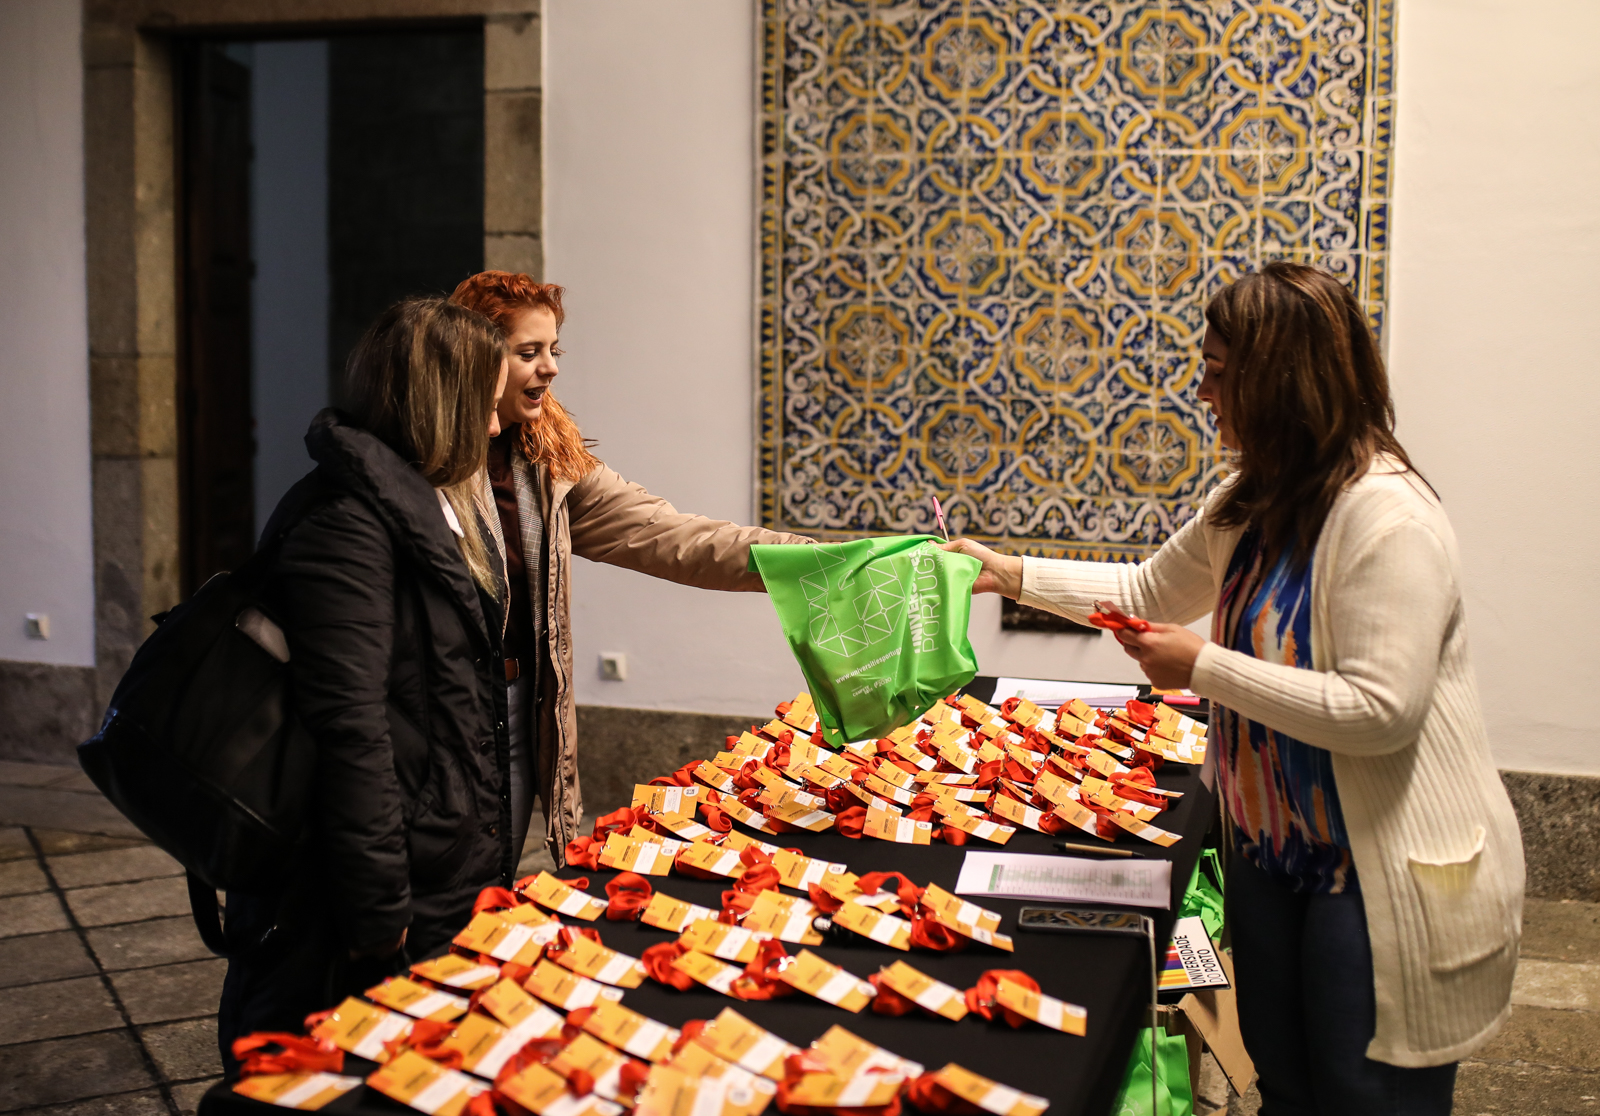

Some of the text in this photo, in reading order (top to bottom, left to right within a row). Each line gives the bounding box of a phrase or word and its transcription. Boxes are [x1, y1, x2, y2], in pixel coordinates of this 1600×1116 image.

[1174, 934, 1206, 985] UNIVERSIDADE
[1197, 949, 1224, 983] DO PORTO
